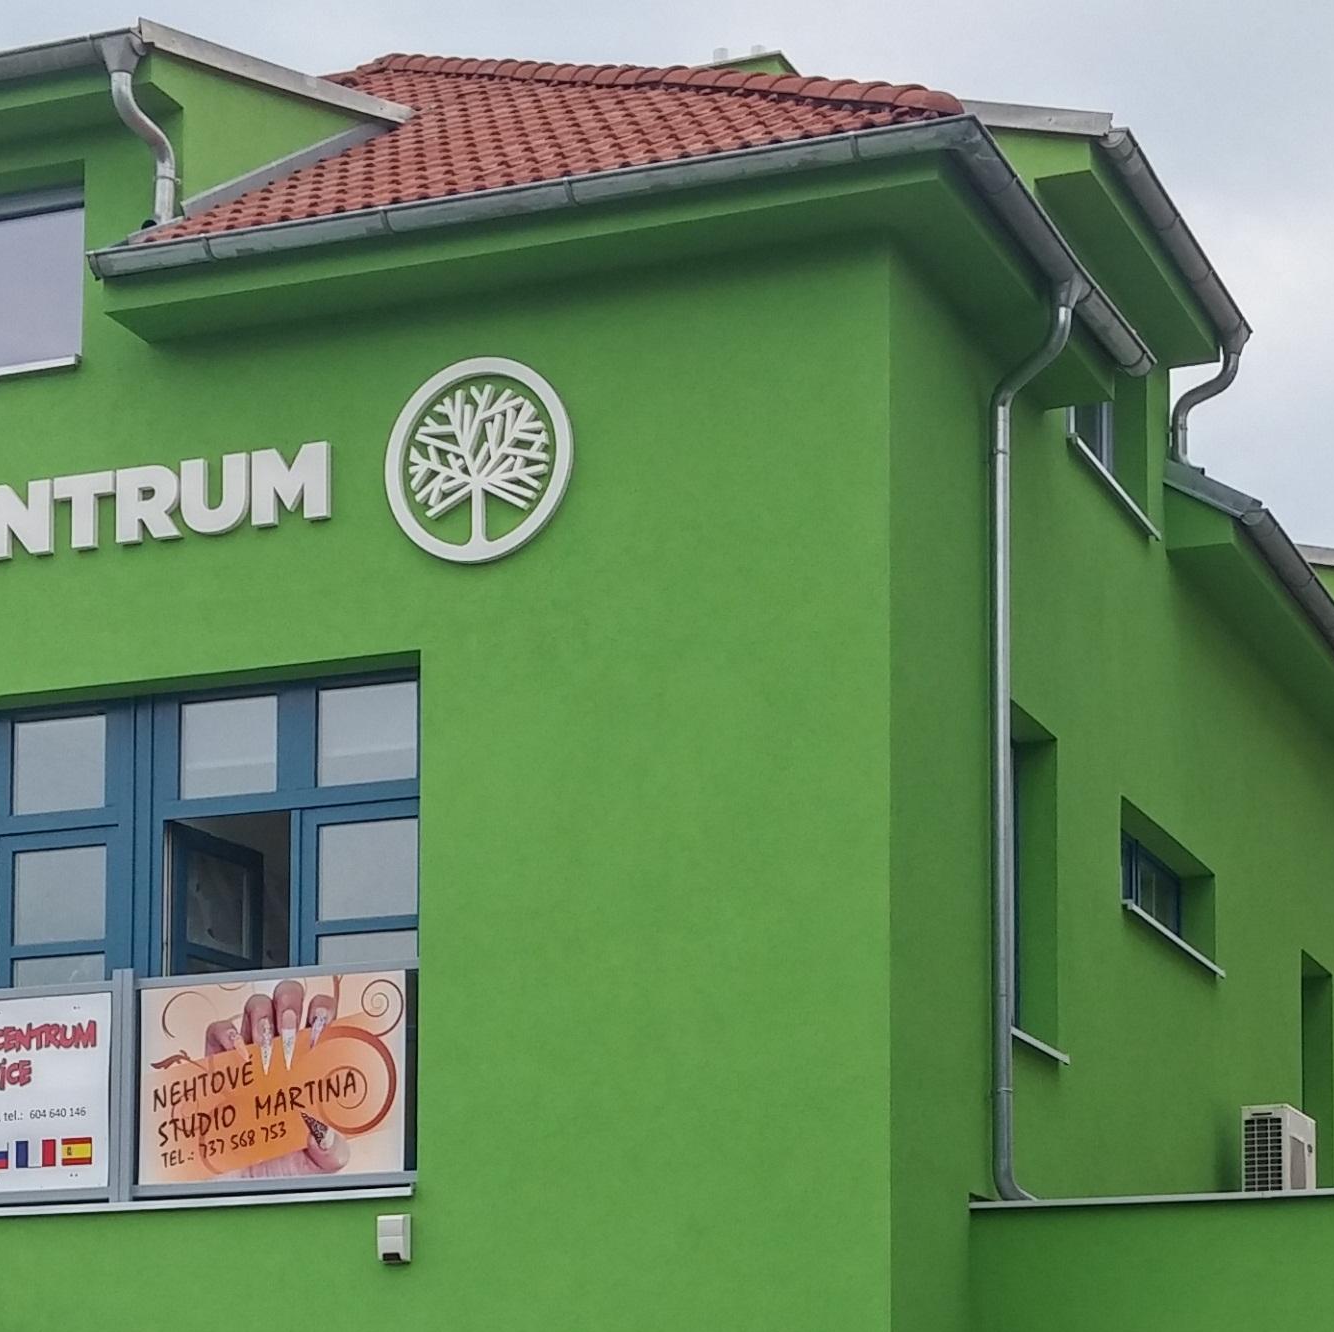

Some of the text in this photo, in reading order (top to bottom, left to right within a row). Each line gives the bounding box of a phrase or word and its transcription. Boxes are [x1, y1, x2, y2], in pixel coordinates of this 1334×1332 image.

[152, 1054, 255, 1113] NEHTOVÉ
[157, 1069, 357, 1147] STUDIO MARTINA
[4, 1109, 23, 1122] tel.:
[29, 1109, 47, 1120] 604
[49, 1107, 67, 1119] 640
[69, 1106, 87, 1118] 146
[198, 1138, 225, 1159] 737
[230, 1127, 256, 1150] 568
[260, 1120, 287, 1145] 753
